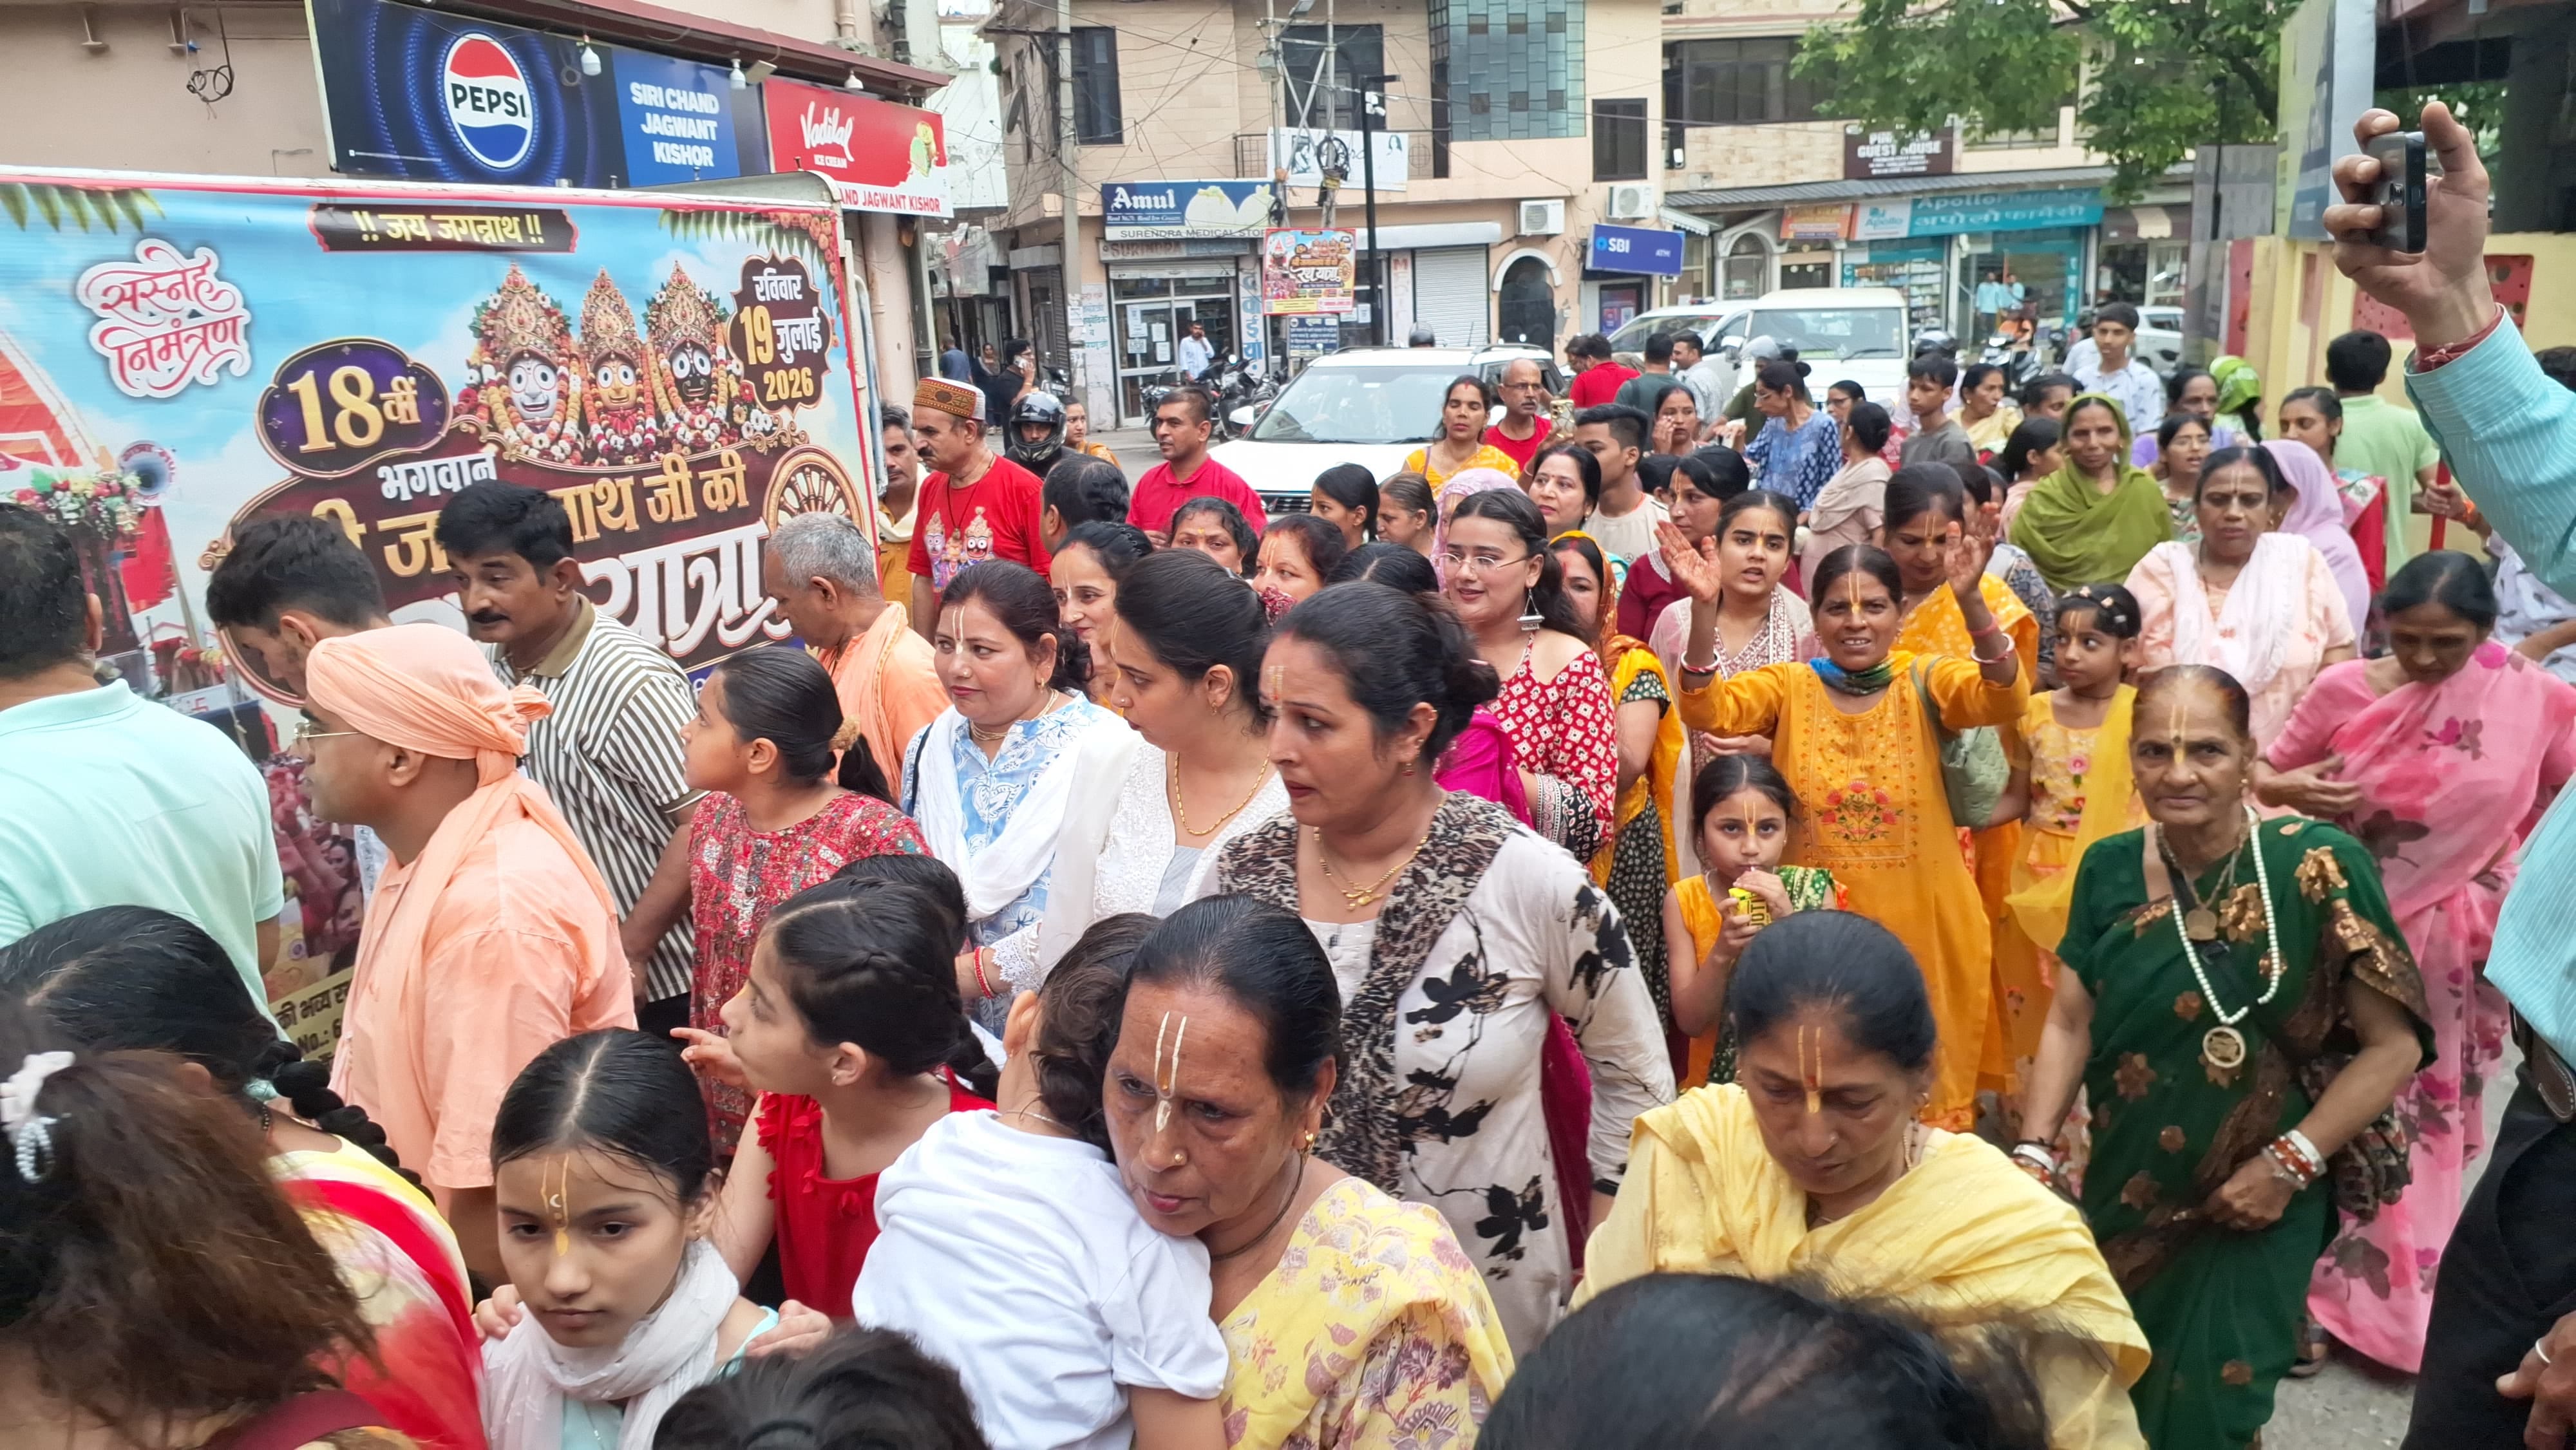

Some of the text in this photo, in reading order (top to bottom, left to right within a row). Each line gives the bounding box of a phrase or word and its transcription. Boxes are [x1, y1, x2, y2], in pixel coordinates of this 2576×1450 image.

[451, 82, 526, 118] PEPSI
[629, 81, 720, 115] SIRI CHAND
[641, 112, 717, 141] JAGWANT
[800, 100, 855, 162] Vadilal
[653, 141, 714, 167] KISHOR
[1857, 143, 1897, 158] GUEST
[840, 187, 942, 213] AND JAGWANT KISHOR
[1111, 186, 1177, 212] Amul
[1917, 193, 1996, 211] Apollo
[378, 214, 432, 241] जय
[431, 214, 523, 243] जगन्नाथ
[1121, 229, 1183, 238] SURENDRA
[1186, 229, 1236, 238] MEDICAL
[1608, 237, 1630, 253] SBI
[86, 246, 236, 326] सस्नेह
[752, 267, 803, 301] रविवार
[739, 305, 822, 365] 19 जुलाई
[99, 315, 244, 391] निमंत्रण
[763, 366, 814, 402] 2026
[377, 453, 498, 501] भगवान
[642, 452, 697, 524] जी
[698, 449, 750, 513] की
[299, 990, 332, 1019] भव्य
